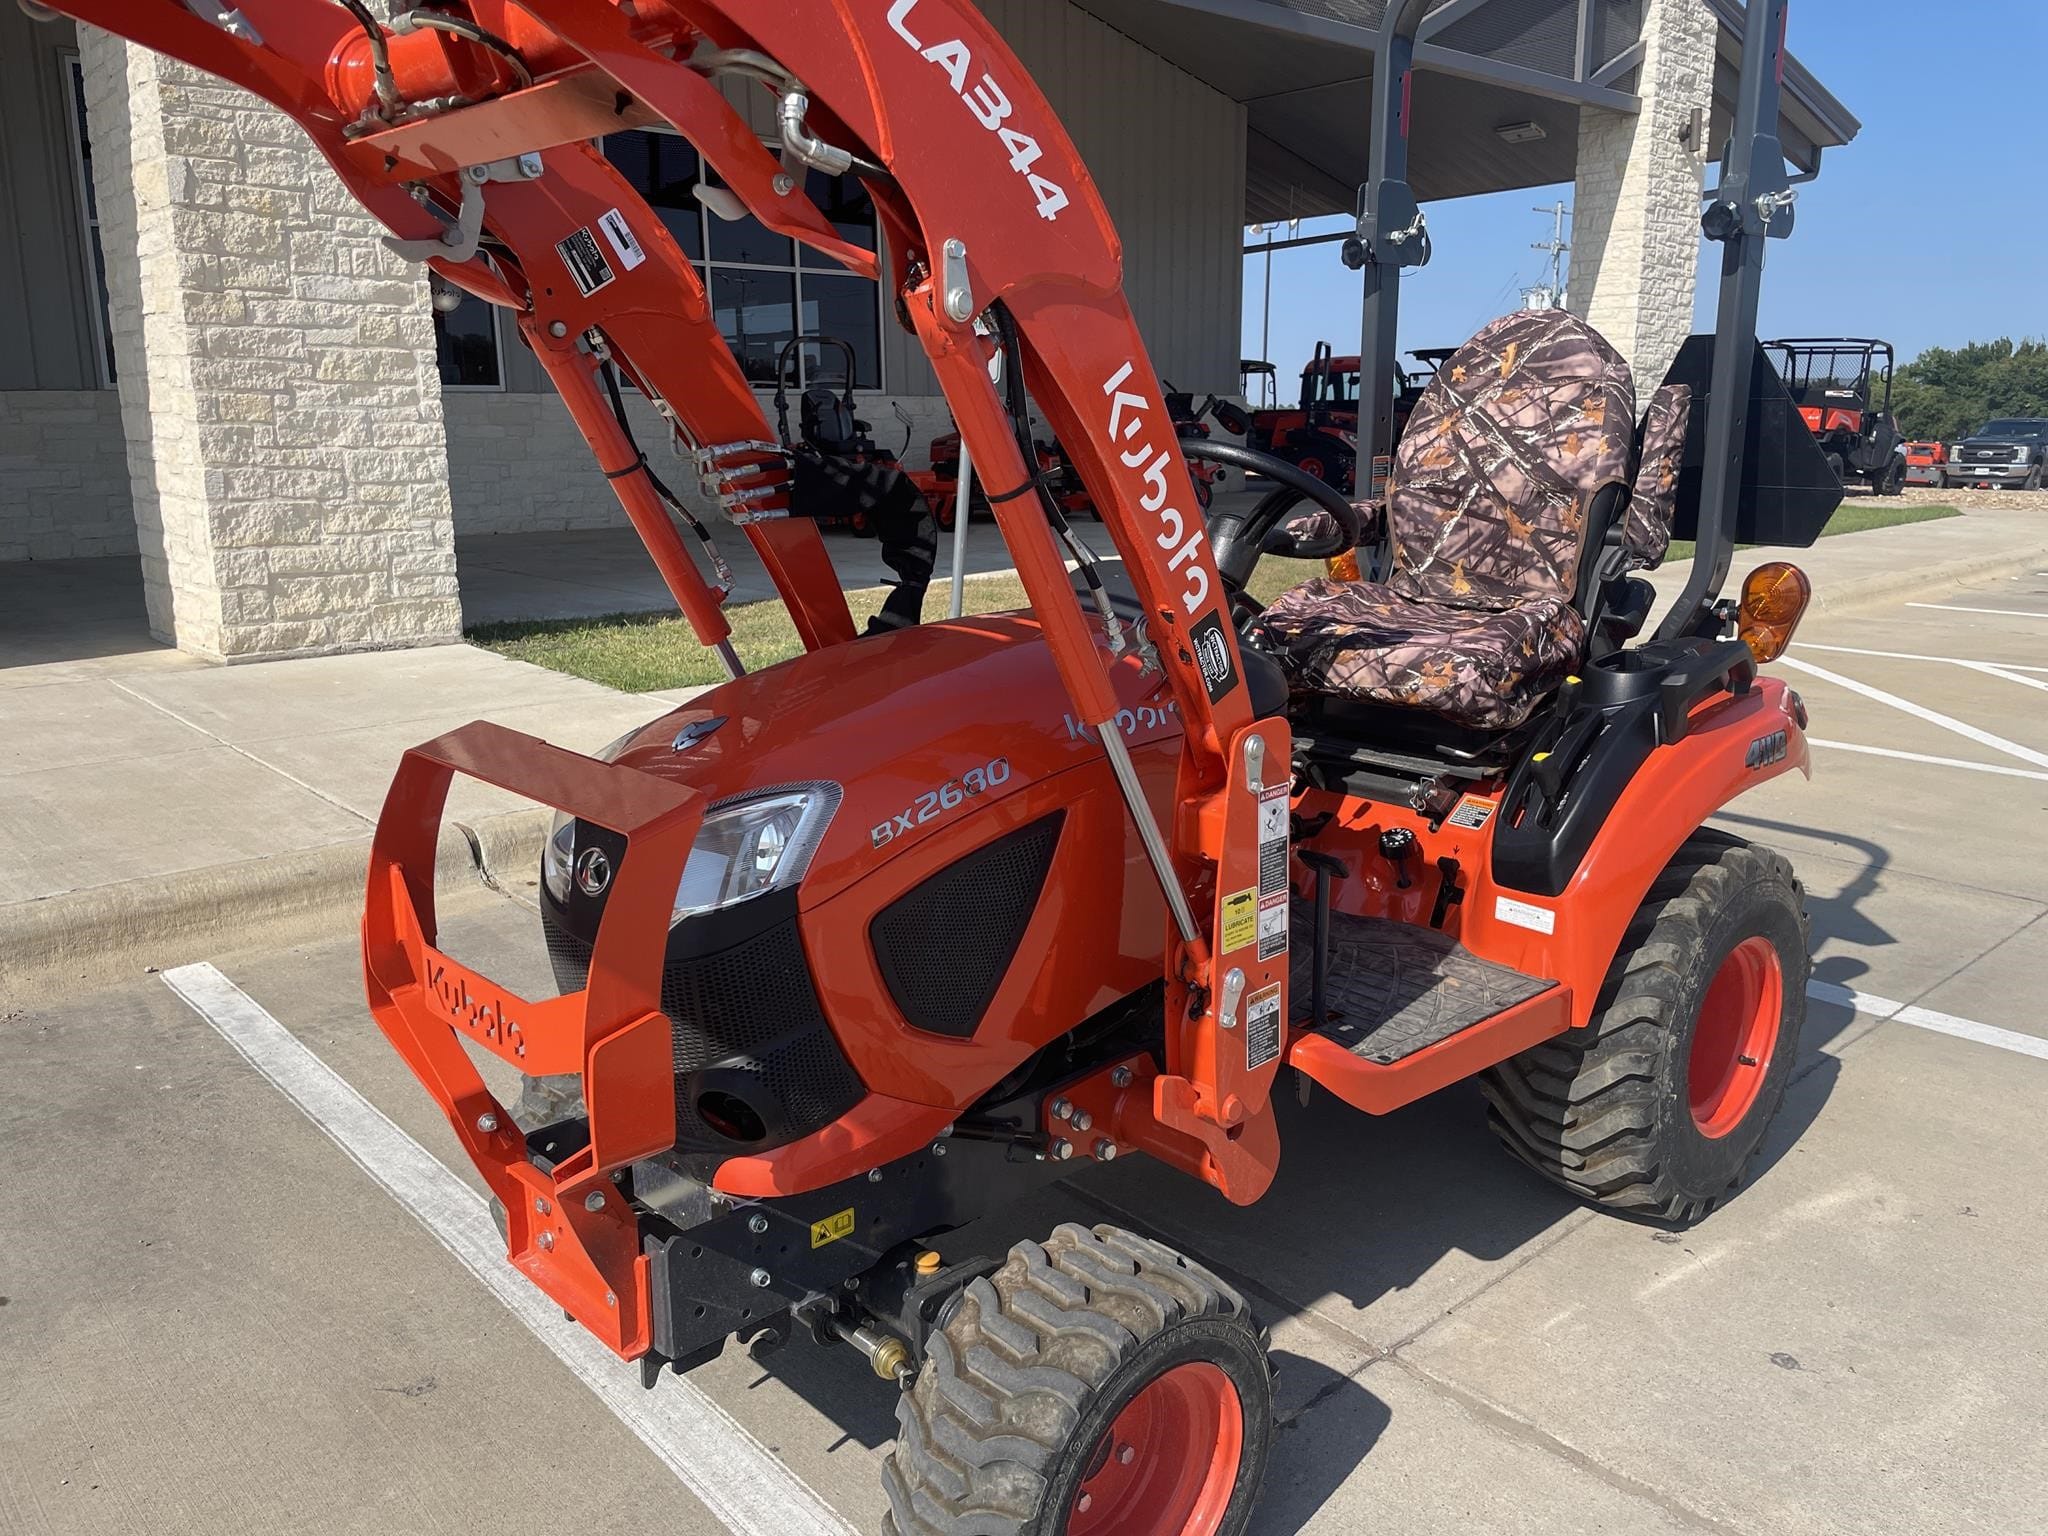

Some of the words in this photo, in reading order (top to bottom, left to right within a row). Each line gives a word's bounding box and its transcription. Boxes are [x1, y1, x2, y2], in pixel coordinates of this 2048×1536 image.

[887, 0, 1070, 222] LA344
[582, 229, 599, 261] Kubota
[1102, 360, 1209, 615] Kubota
[871, 756, 1011, 849] BX2680
[1265, 786, 1288, 800] DANGER
[1225, 916, 1254, 931] LUBRICATE
[1265, 894, 1287, 908] DANGER
[426, 958, 526, 1059] Kubota
